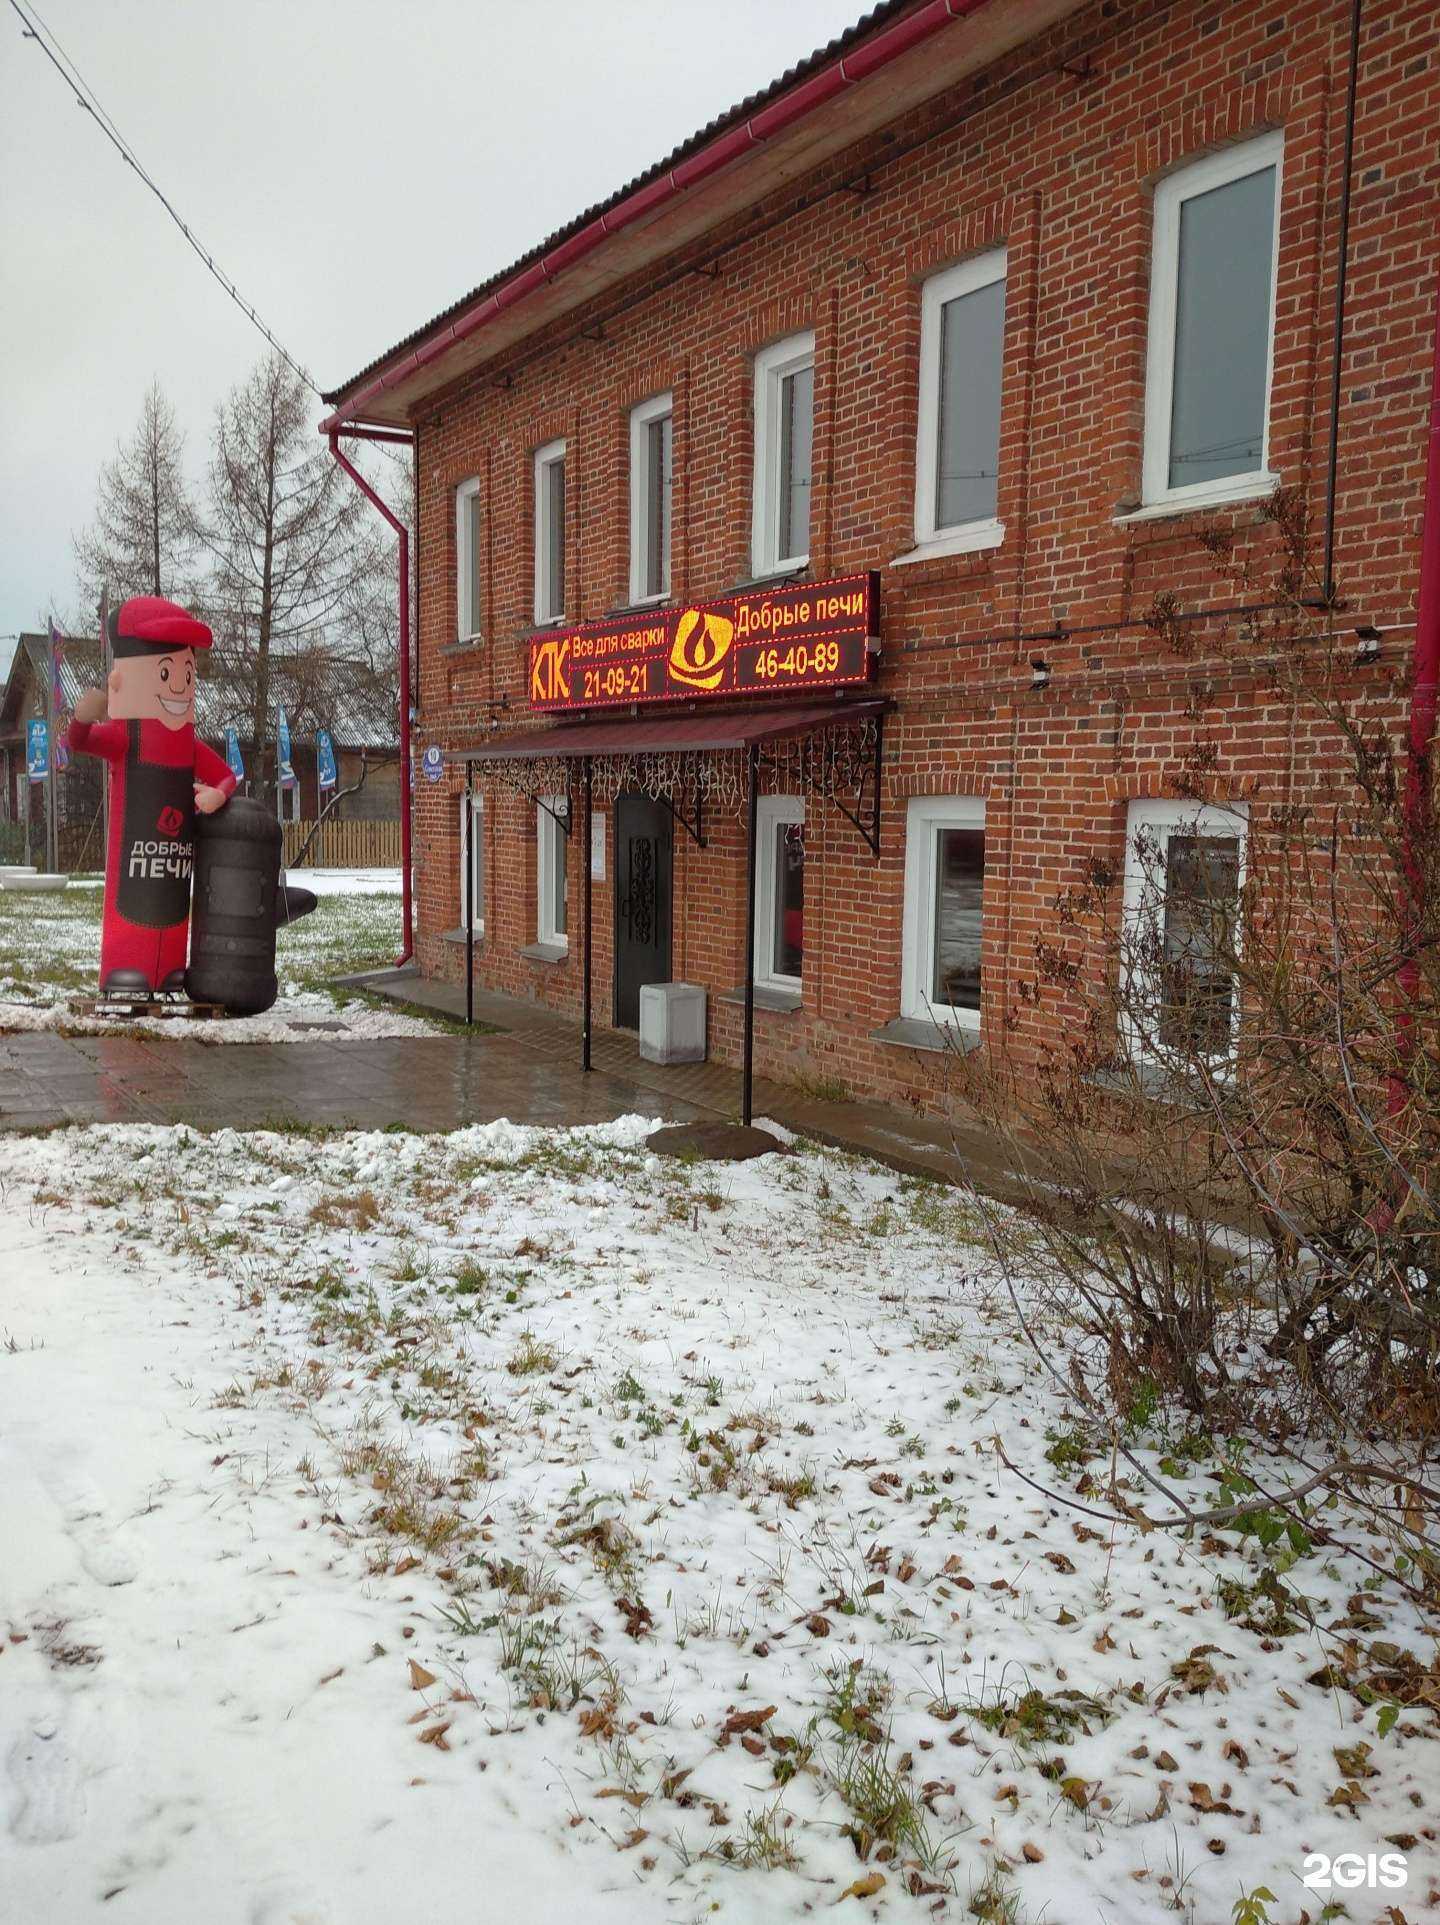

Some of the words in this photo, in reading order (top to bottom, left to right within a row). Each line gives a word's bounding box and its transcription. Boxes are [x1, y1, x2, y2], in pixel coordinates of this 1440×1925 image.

[738, 602, 810, 637] Добрые
[816, 593, 863, 620] печи
[573, 636, 593, 657] Все
[595, 636, 618, 658] для
[621, 627, 665, 653] сварки
[532, 640, 570, 701] КТК
[755, 642, 839, 678] 46-40-89
[584, 664, 647, 698] 21-09-21
[131, 840, 192, 856] ДОБРЫЕ
[129, 857, 192, 879] ПЕЧИ
